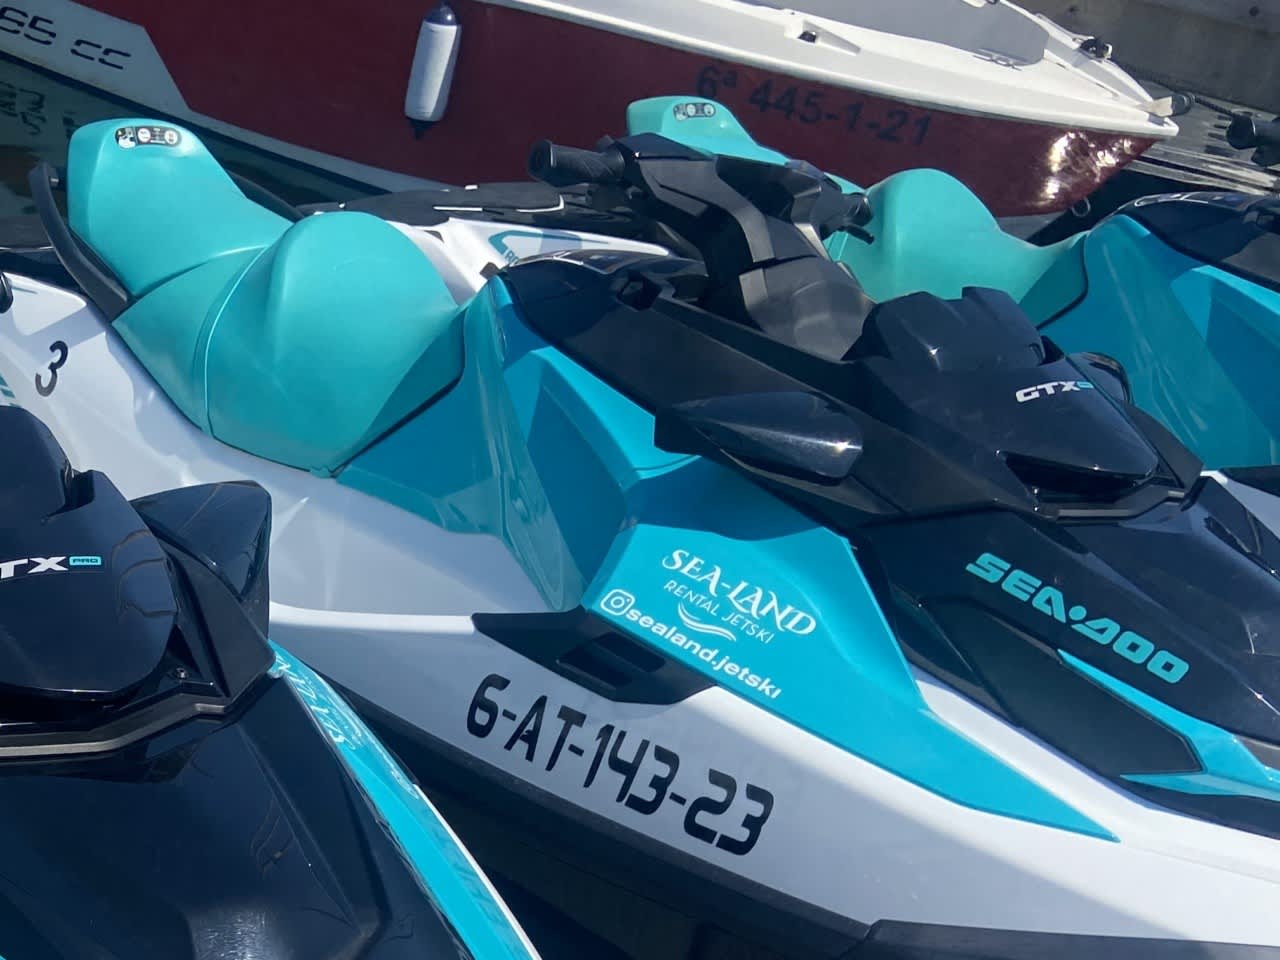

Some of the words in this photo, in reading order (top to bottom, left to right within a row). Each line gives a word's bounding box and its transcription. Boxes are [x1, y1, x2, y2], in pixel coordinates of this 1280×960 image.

[35, 340, 68, 397] 3
[1015, 381, 1081, 403] GTX
[662, 548, 817, 637] SEA-LAND
[663, 579, 720, 617] RENTAL
[721, 609, 776, 645] JETSKI
[466, 673, 775, 857] 6-AT-143-23
